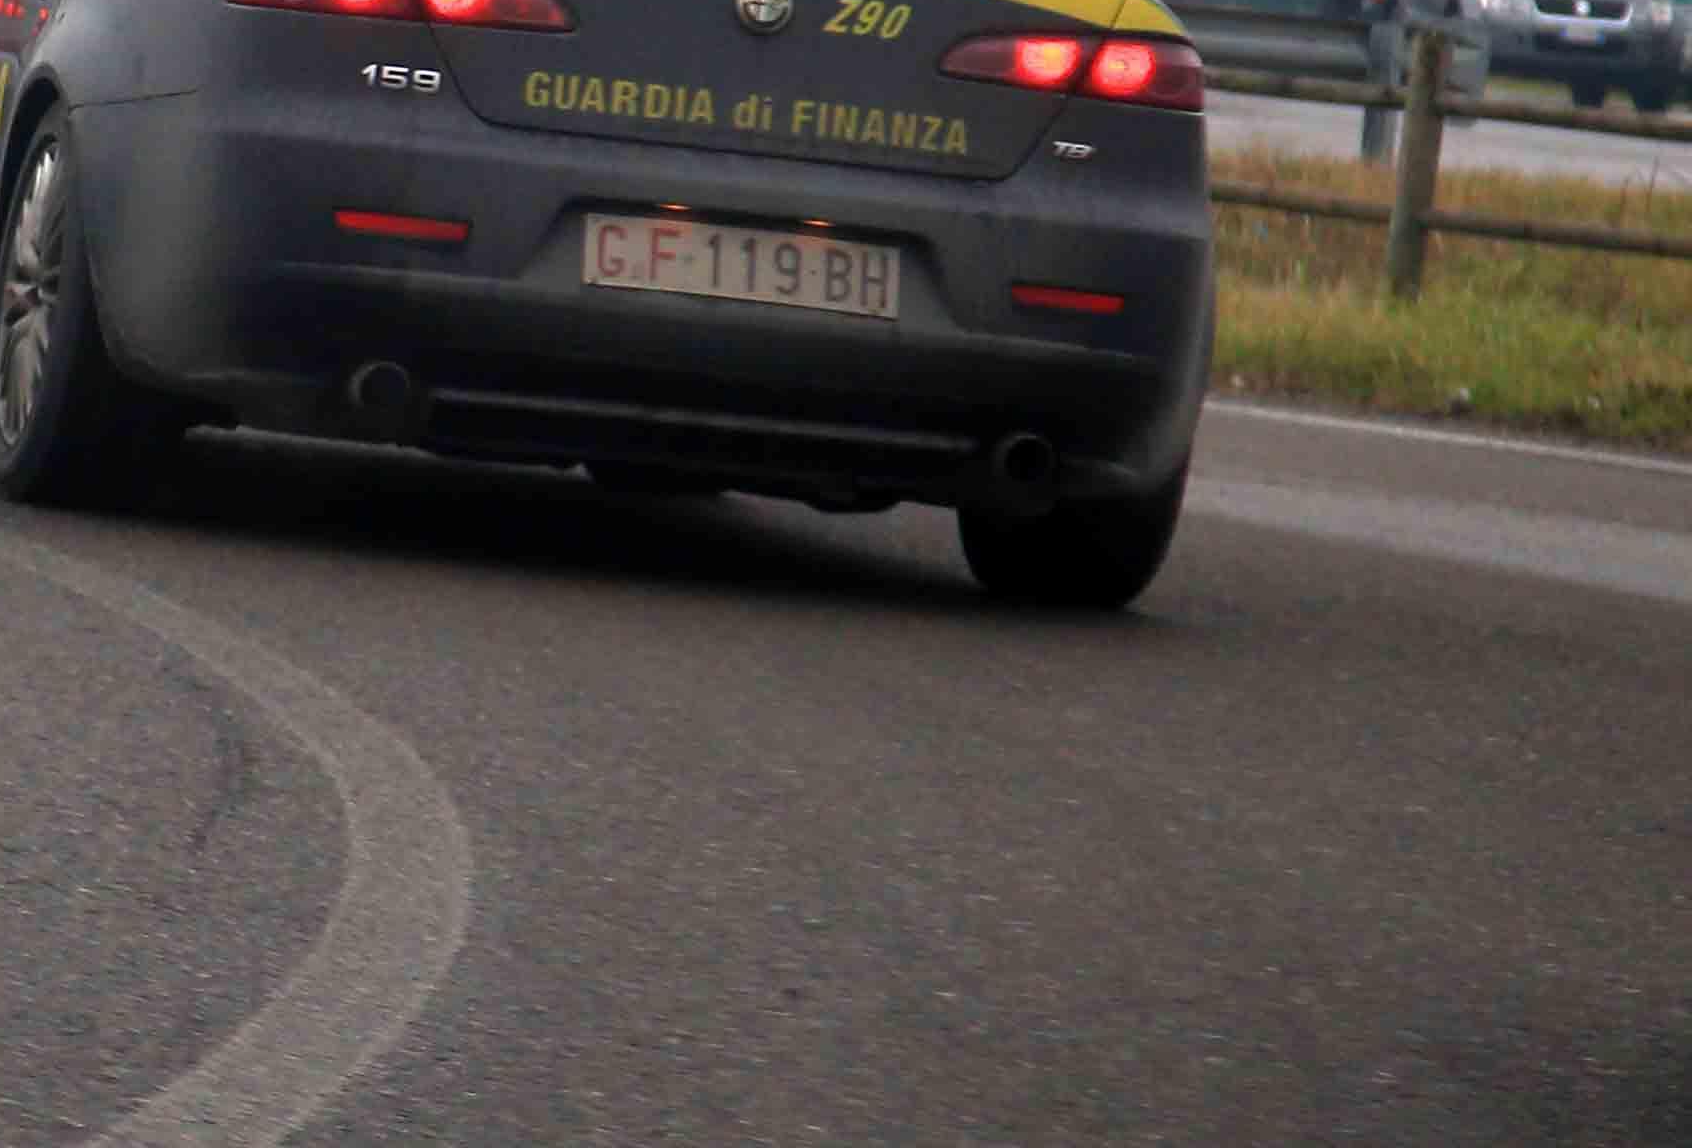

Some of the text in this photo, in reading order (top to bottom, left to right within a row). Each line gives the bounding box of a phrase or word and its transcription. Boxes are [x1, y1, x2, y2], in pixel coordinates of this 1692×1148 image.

[361, 63, 441, 93] 159
[524, 70, 969, 155] GUARDIA di FINANZA
